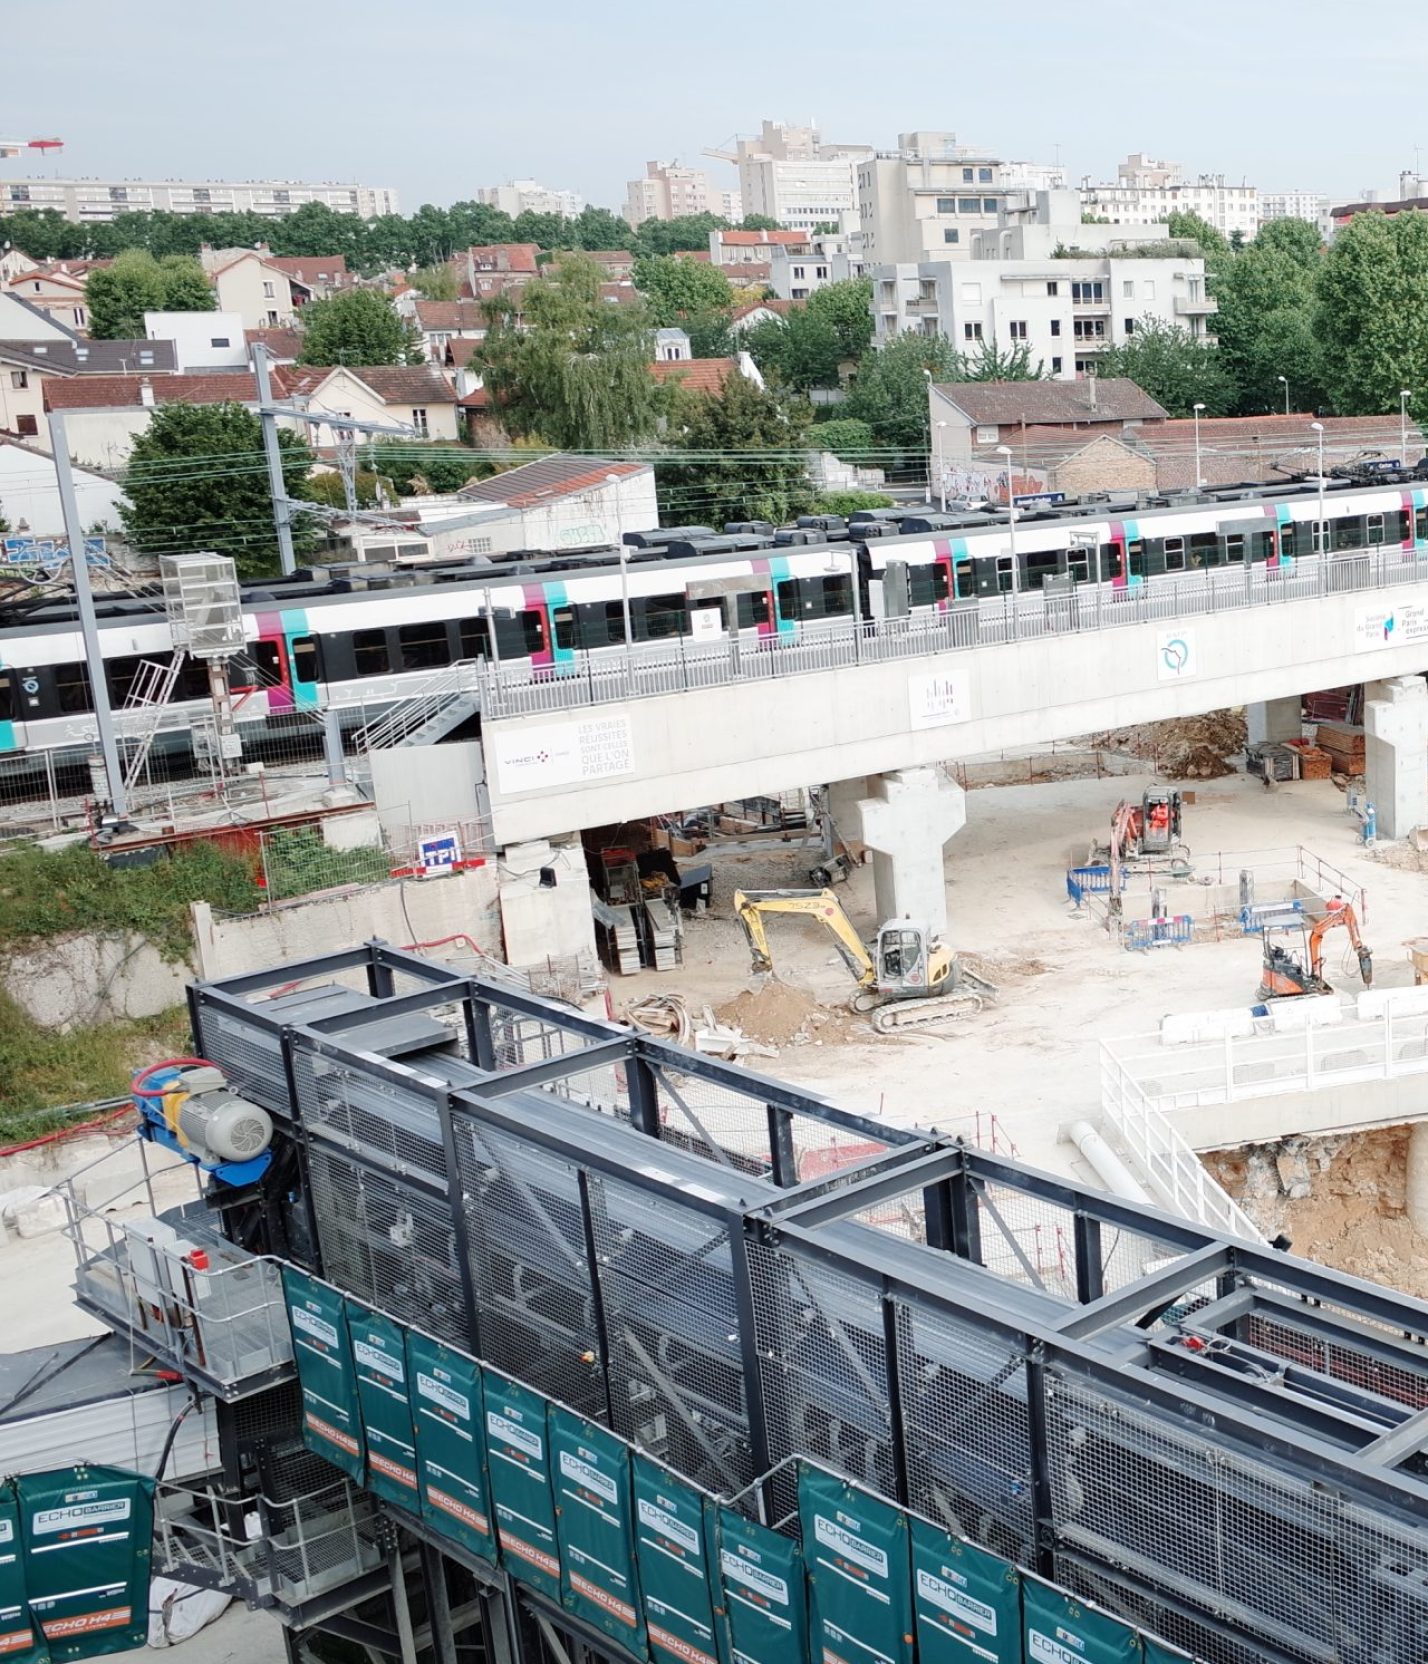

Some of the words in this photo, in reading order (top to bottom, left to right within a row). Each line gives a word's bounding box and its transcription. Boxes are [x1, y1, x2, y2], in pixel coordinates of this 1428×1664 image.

[578, 724, 593, 735] LES
[504, 755, 535, 765] VINCI
[582, 760, 630, 775] PARTAGE
[425, 848, 456, 867] TPI
[89, 1613, 112, 1625] H4
